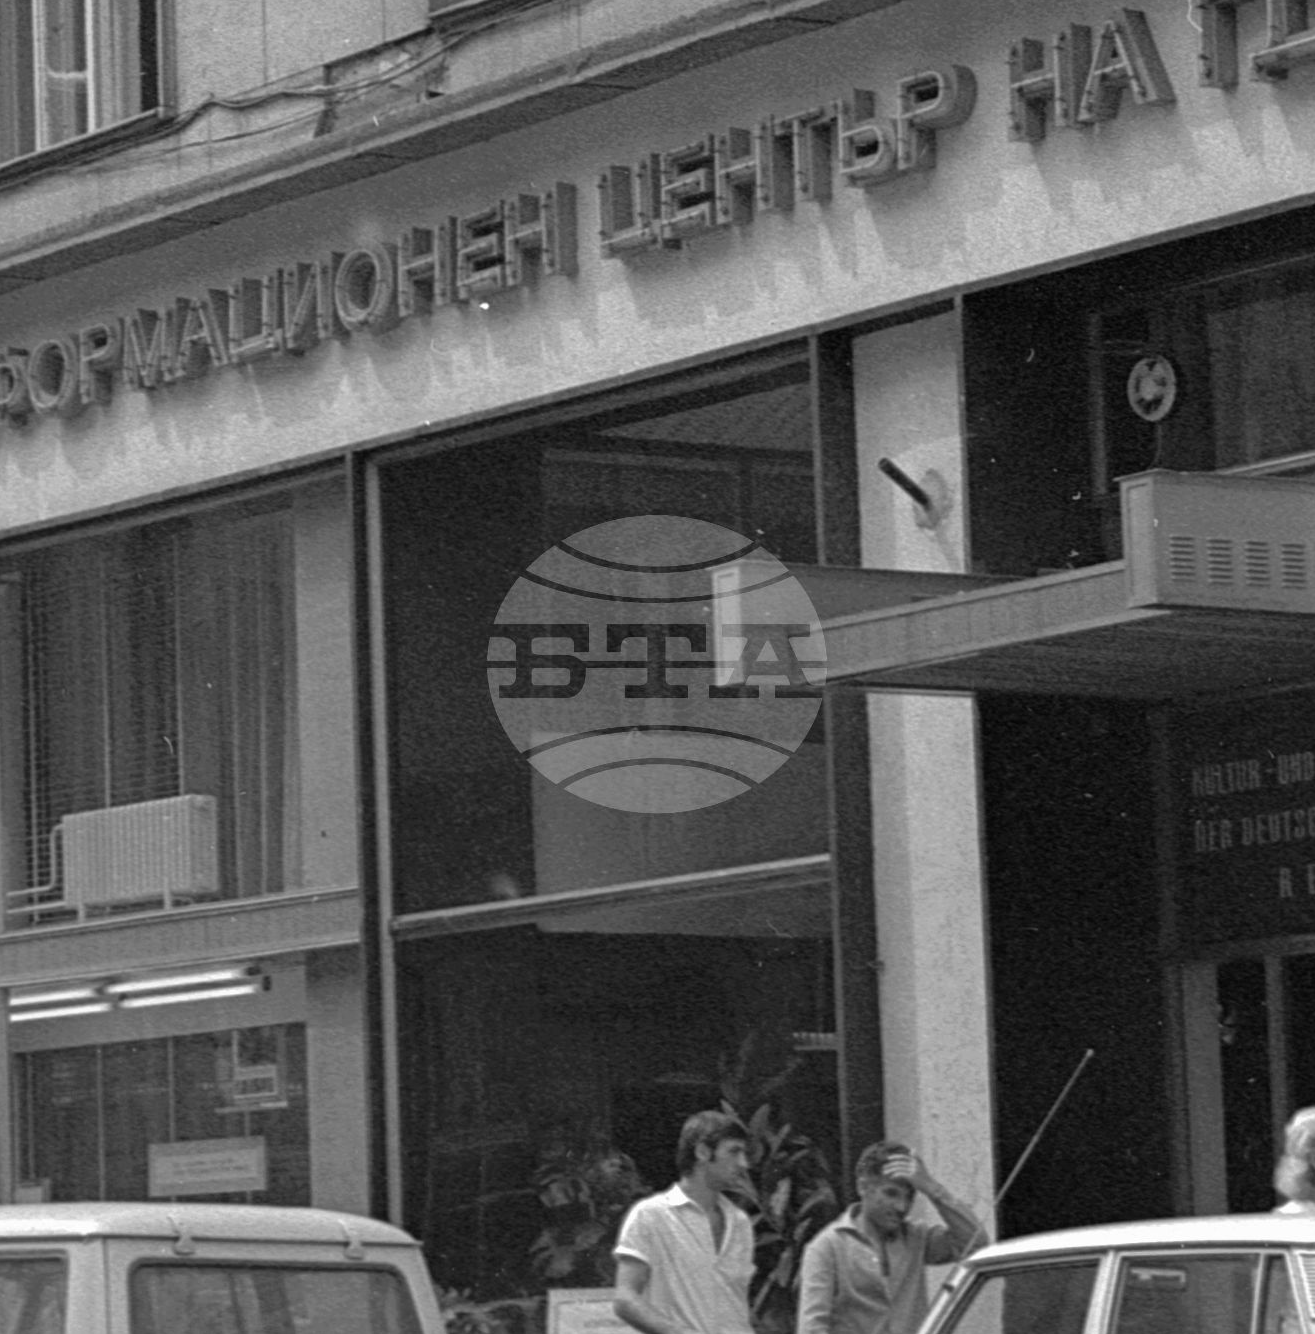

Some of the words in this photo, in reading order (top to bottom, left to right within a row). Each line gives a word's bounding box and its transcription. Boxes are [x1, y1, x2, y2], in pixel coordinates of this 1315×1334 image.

[598, 65, 978, 259] ЦЕНТЪР
[1008, 7, 1177, 142] НА
[1194, 819, 1232, 853] DER
